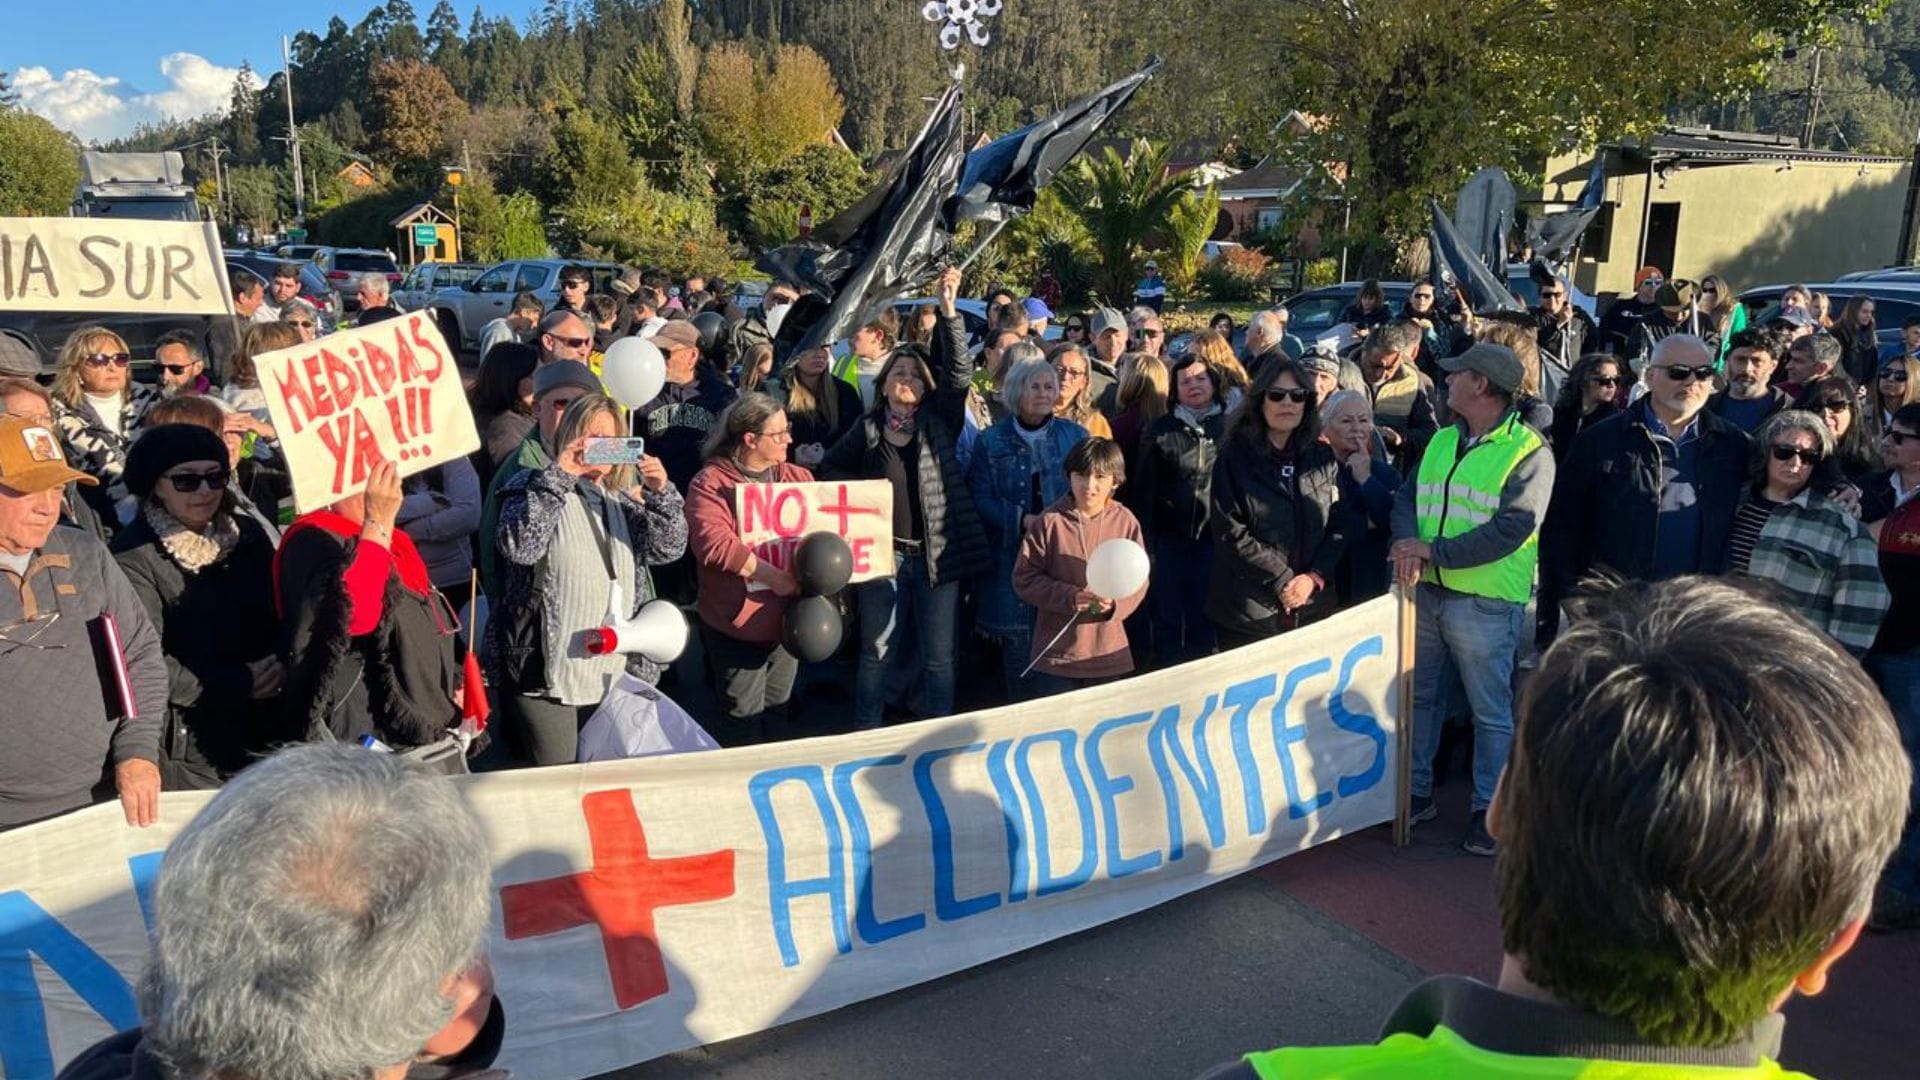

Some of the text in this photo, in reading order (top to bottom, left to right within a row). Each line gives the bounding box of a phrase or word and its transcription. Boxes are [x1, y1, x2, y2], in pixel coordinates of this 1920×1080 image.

[79, 235, 202, 300] SUR
[743, 482, 807, 537] NO
[747, 635, 1387, 967] ACCIDENTES
